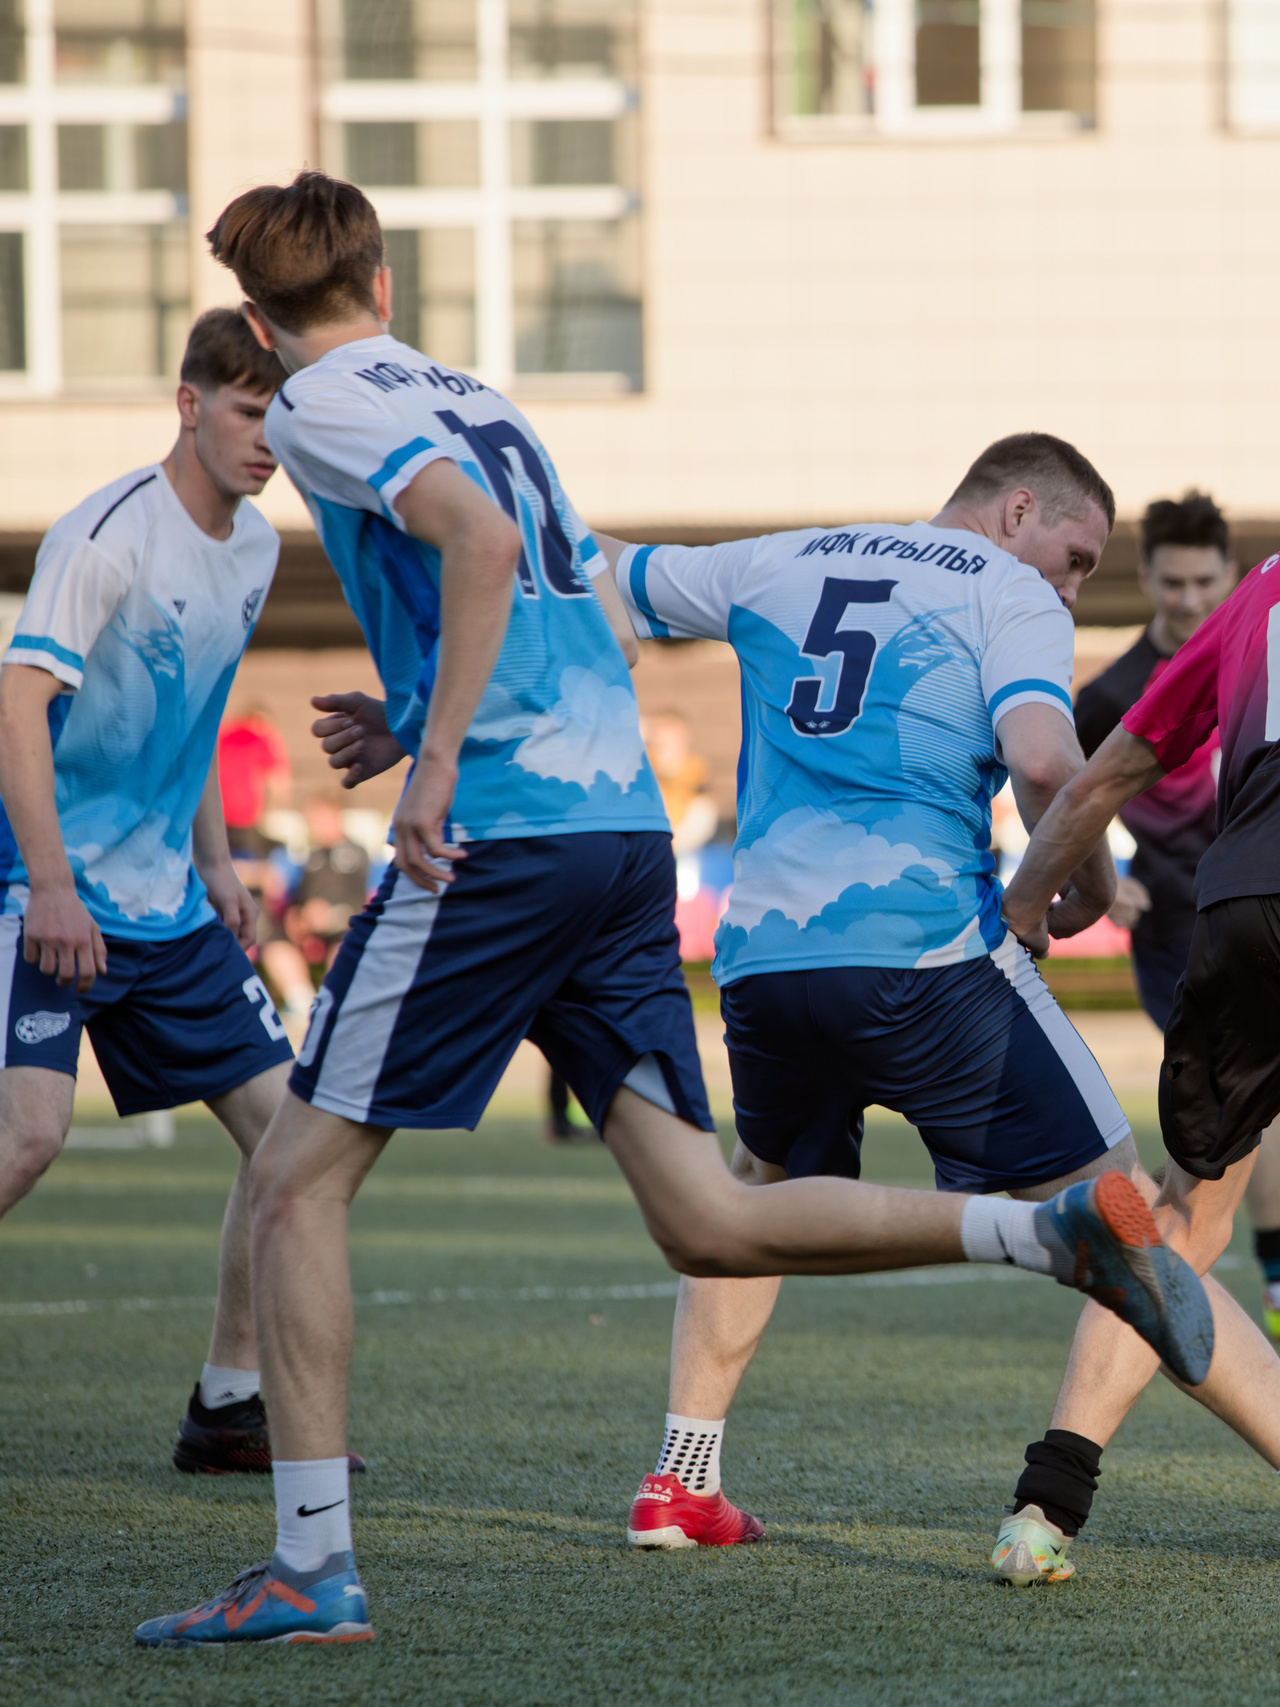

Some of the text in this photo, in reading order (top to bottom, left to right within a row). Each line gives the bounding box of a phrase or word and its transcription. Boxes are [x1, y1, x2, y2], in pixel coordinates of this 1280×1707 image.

[794, 532, 990, 575] МФК КРЫЛЬЯ
[785, 575, 901, 738] 5
